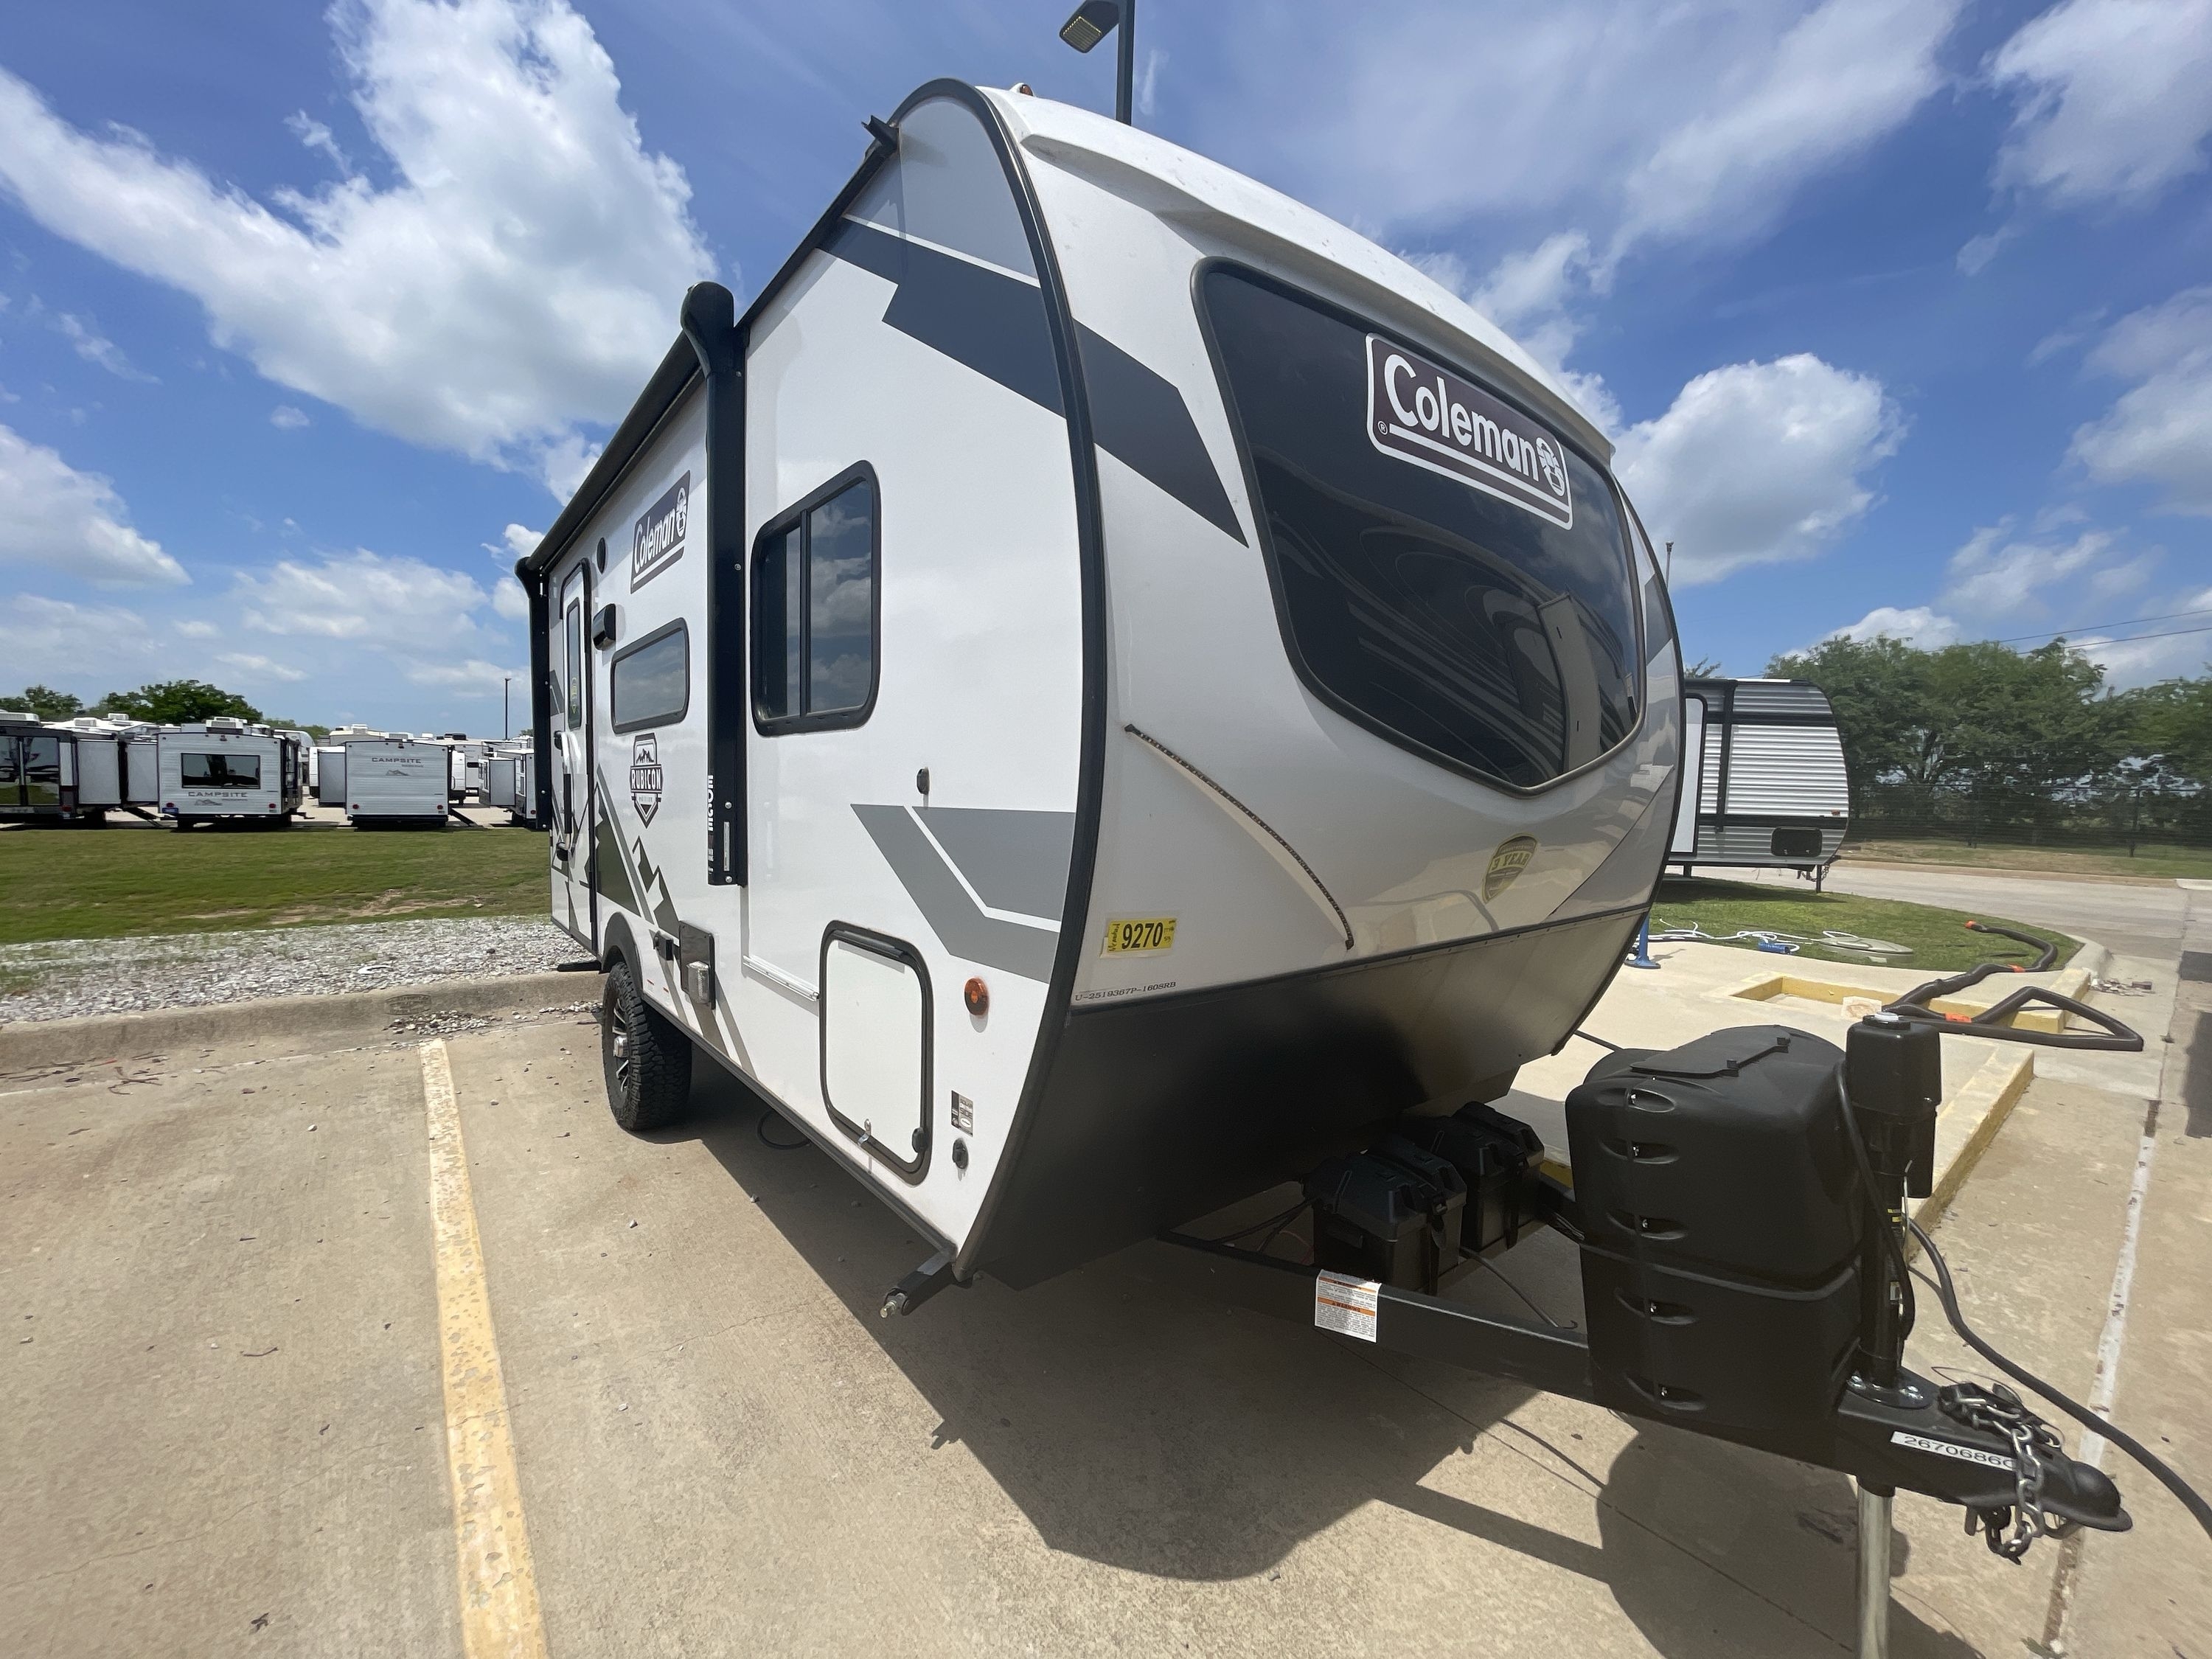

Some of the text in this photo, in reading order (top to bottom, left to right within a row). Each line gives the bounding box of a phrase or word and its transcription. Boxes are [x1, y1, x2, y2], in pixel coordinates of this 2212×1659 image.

[1384, 354, 1539, 482] Coleman
[635, 508, 676, 574] Coleman
[631, 768, 661, 790] RUBICON
[1121, 922, 1164, 950] 9270
